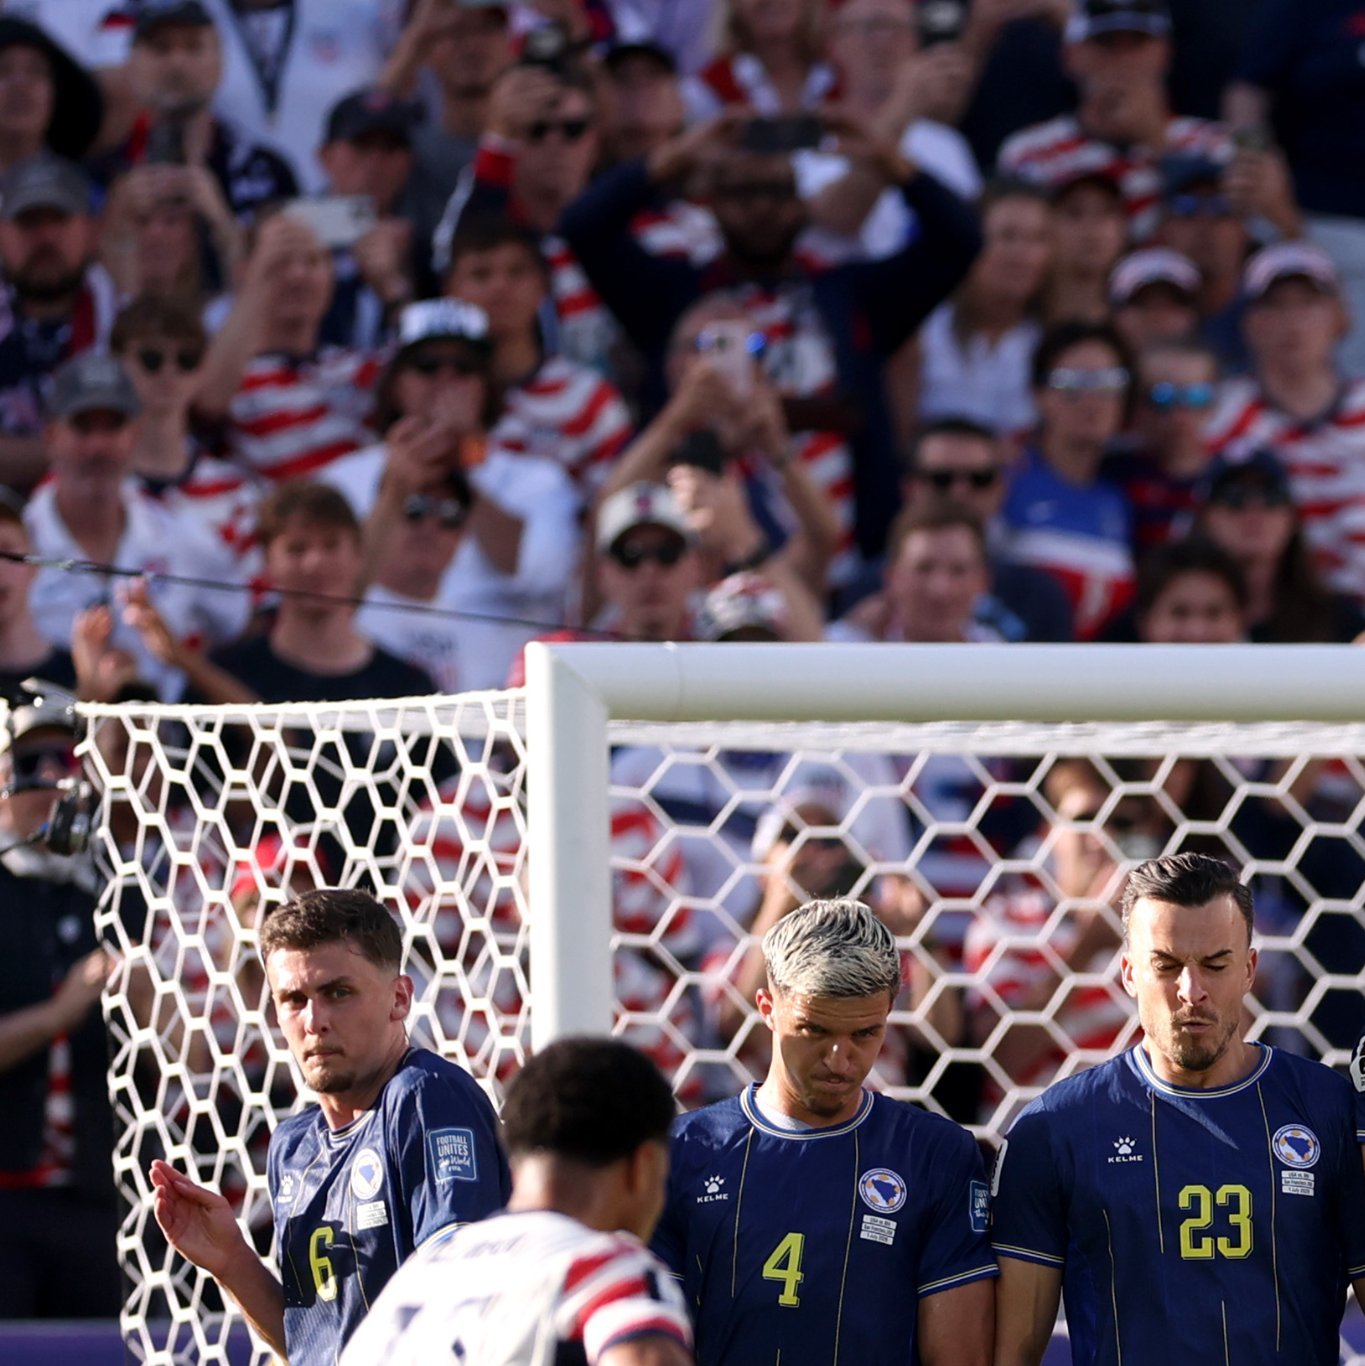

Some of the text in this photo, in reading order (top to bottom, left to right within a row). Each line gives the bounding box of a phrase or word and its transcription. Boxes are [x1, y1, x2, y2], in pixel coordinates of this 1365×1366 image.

[436, 1135, 467, 1145] FOOTBALL
[437, 1144, 469, 1157] UNITES
[1107, 1154, 1144, 1163] KELME
[697, 1193, 729, 1204] KELME
[1178, 1184, 1254, 1261] 23
[309, 1226, 338, 1301] 6
[762, 1232, 805, 1308] 4
